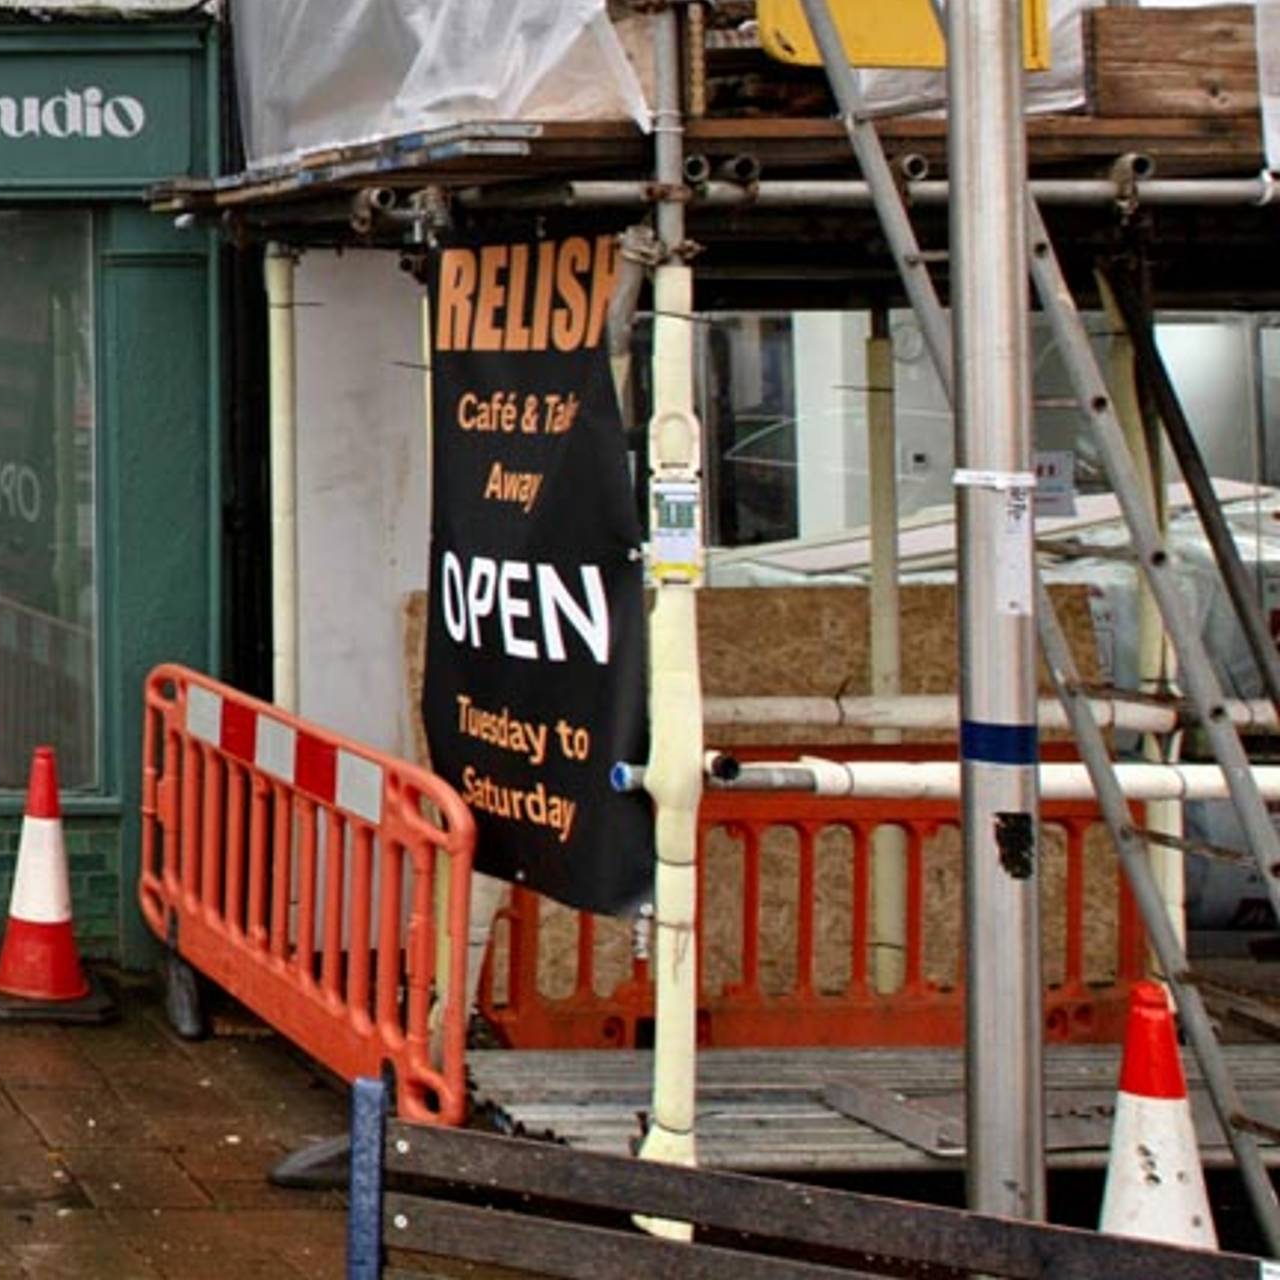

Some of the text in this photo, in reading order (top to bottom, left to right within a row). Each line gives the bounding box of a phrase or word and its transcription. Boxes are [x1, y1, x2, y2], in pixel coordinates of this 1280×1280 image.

[435, 235, 623, 352] RELISH
[458, 389, 518, 432] Café
[521, 393, 539, 436] &
[483, 460, 544, 514] Away
[442, 550, 610, 665] OPEN
[456, 694, 590, 766] Tuesday to
[461, 765, 578, 843] Saturday
